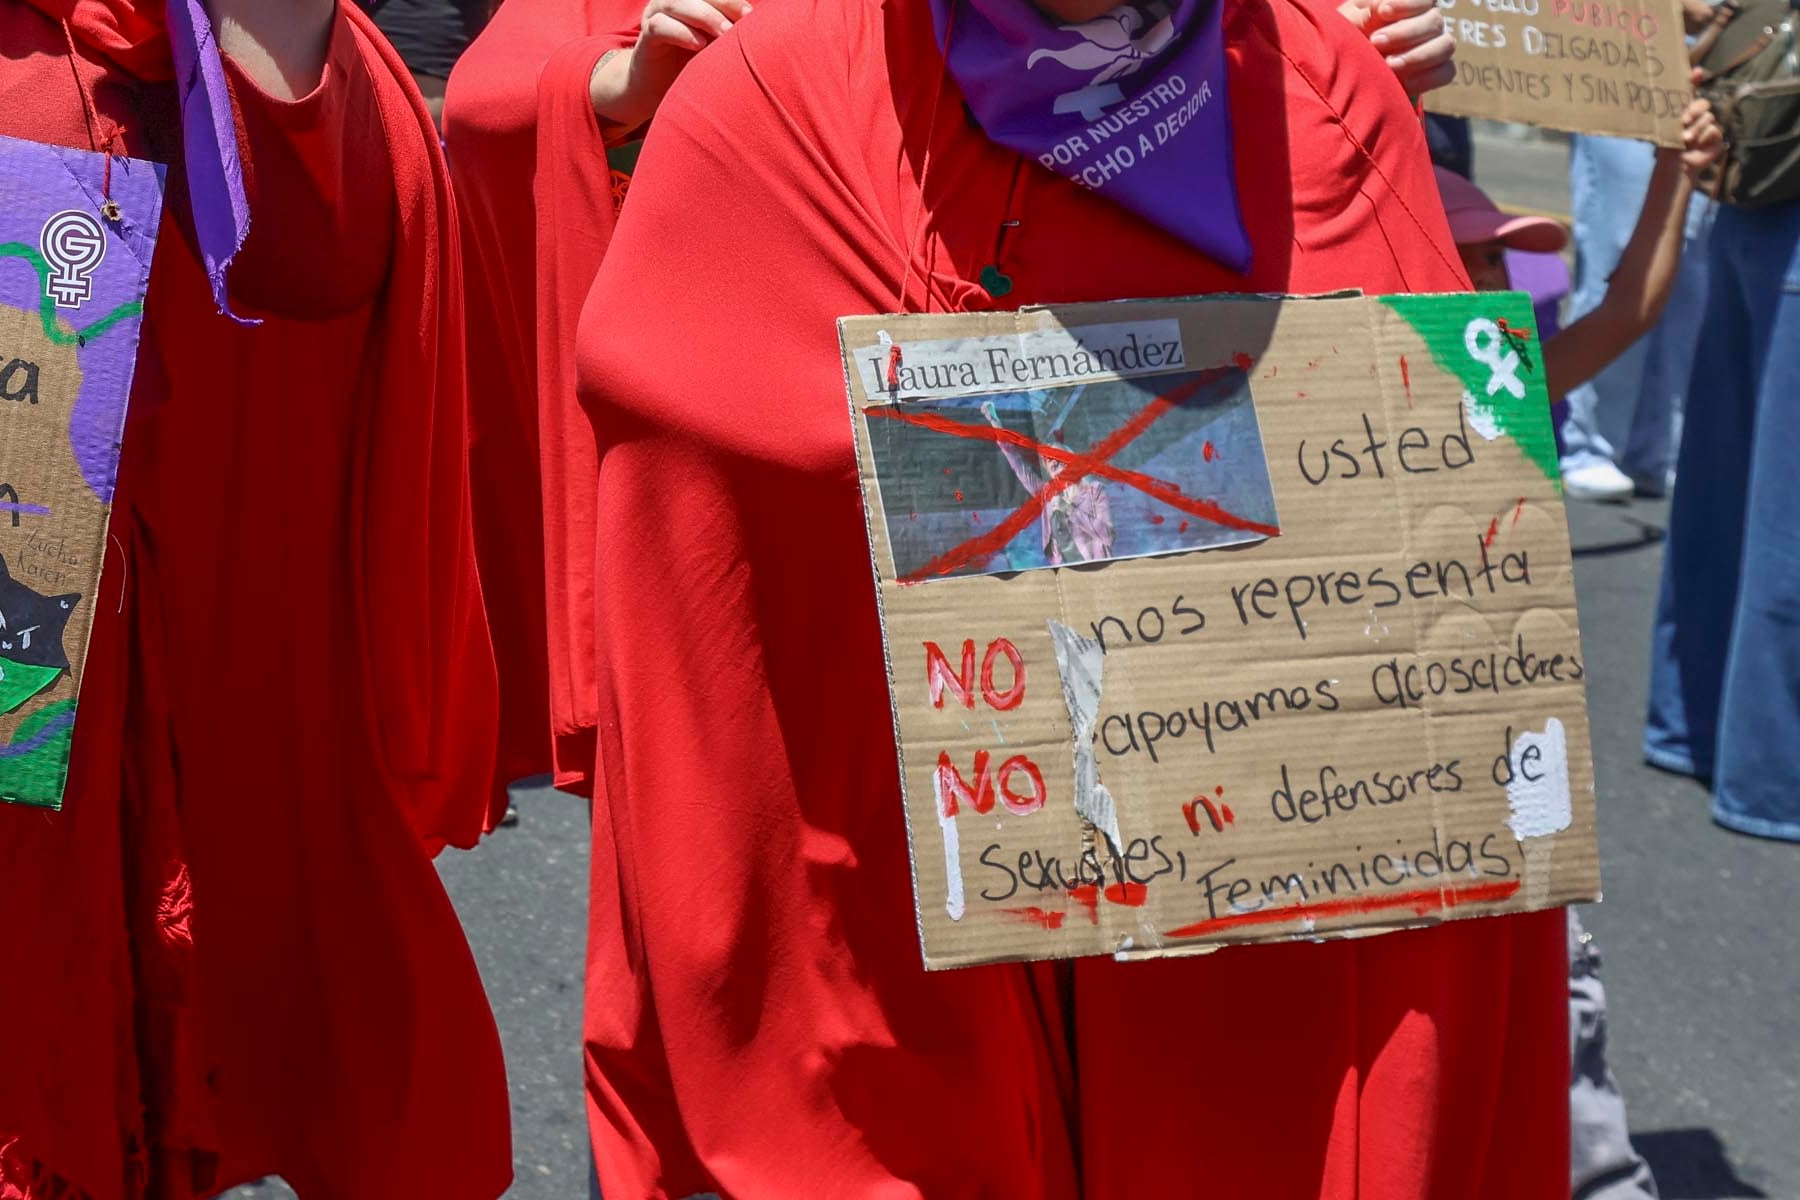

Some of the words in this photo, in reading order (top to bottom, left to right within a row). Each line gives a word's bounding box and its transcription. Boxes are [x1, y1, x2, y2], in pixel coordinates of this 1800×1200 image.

[1522, 25, 1664, 77] DELGADAS
[1563, 72, 1573, 103] Y
[1580, 73, 1620, 105] SIN
[1038, 135, 1090, 171] POR
[1086, 75, 1187, 144] NUESTRO
[1138, 133, 1155, 158] A
[1154, 80, 1213, 146] DECIDIR
[869, 351, 981, 395] Laura
[987, 330, 1184, 383] Fernández
[1297, 400, 1475, 486] usted
[922, 637, 1027, 711] NO
[1089, 595, 1205, 655] nos
[1230, 532, 1531, 640] representa
[937, 750, 1047, 818] NO
[1104, 679, 1340, 764] apoyamos
[1181, 785, 1236, 836] ni
[1270, 760, 1464, 826] defensores
[1491, 725, 1545, 781] de
